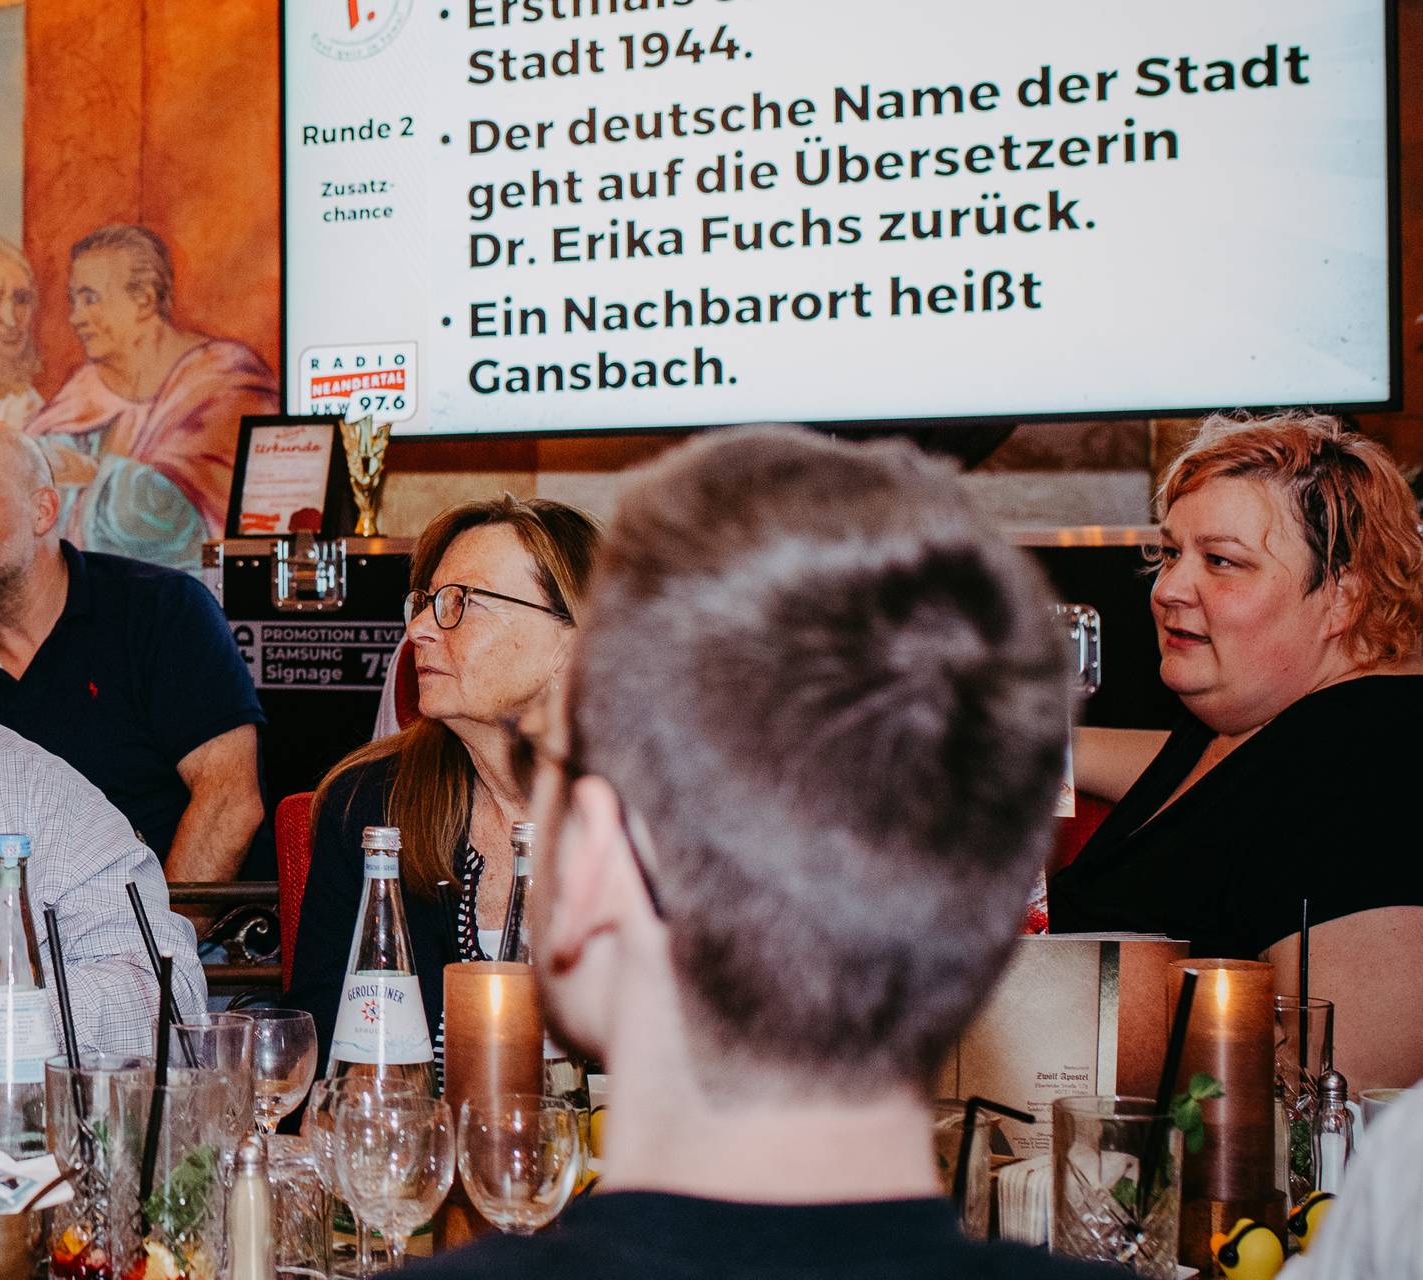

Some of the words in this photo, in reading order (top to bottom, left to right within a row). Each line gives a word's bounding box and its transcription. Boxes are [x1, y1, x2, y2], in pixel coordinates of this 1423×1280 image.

[468, 38, 605, 84] Stadt
[619, 24, 752, 71] 1944.
[469, 119, 554, 154] Der
[568, 92, 816, 145] deutsche
[834, 82, 1001, 124] Name
[1017, 65, 1118, 108] der
[1136, 43, 1310, 97] Stadt
[303, 119, 391, 145] Runde
[400, 116, 414, 137] 2
[468, 170, 583, 222] geht
[598, 158, 684, 202] auf
[696, 150, 778, 194] die
[795, 117, 1179, 186] Übersetzerin
[321, 179, 395, 198] Zusatz-
[322, 207, 393, 222] chance
[470, 233, 536, 268] Dr.
[553, 219, 683, 263] Erika
[702, 208, 862, 253] Fuchs
[879, 190, 1095, 243] zurück.
[470, 296, 547, 338] Ein
[564, 282, 872, 333] Nachbarort
[890, 269, 1042, 315] heißt
[311, 354, 405, 369] RADIO
[468, 346, 737, 395] Gansbach.
[312, 371, 404, 397] NEANDERTAL
[360, 395, 405, 411] 97.6
[263, 629, 354, 641] PROMOTION
[359, 629, 369, 641] &
[266, 648, 343, 660] SAMSUNG
[267, 663, 343, 683] Signage
[347, 984, 405, 1004] GEROLSTINER
[1060, 1072, 1089, 1081] Apostel
